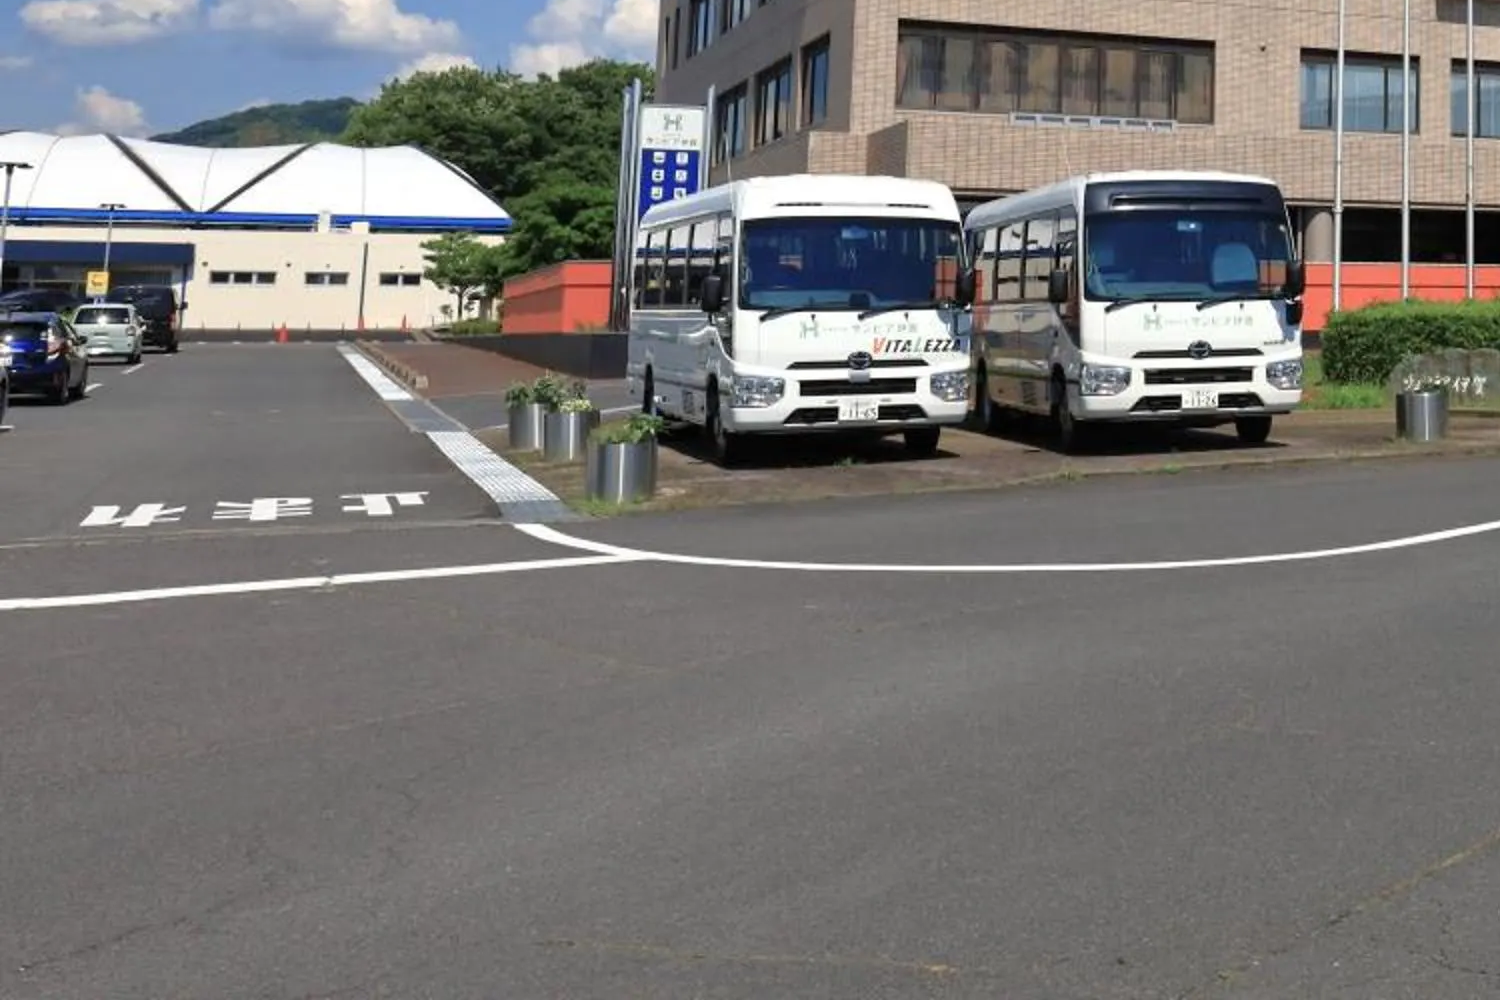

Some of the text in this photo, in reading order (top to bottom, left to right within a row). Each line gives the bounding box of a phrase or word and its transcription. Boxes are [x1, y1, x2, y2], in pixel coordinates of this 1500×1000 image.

[873, 336, 961, 353] VITALEZZA
[79, 490, 429, 527] 止まれ
